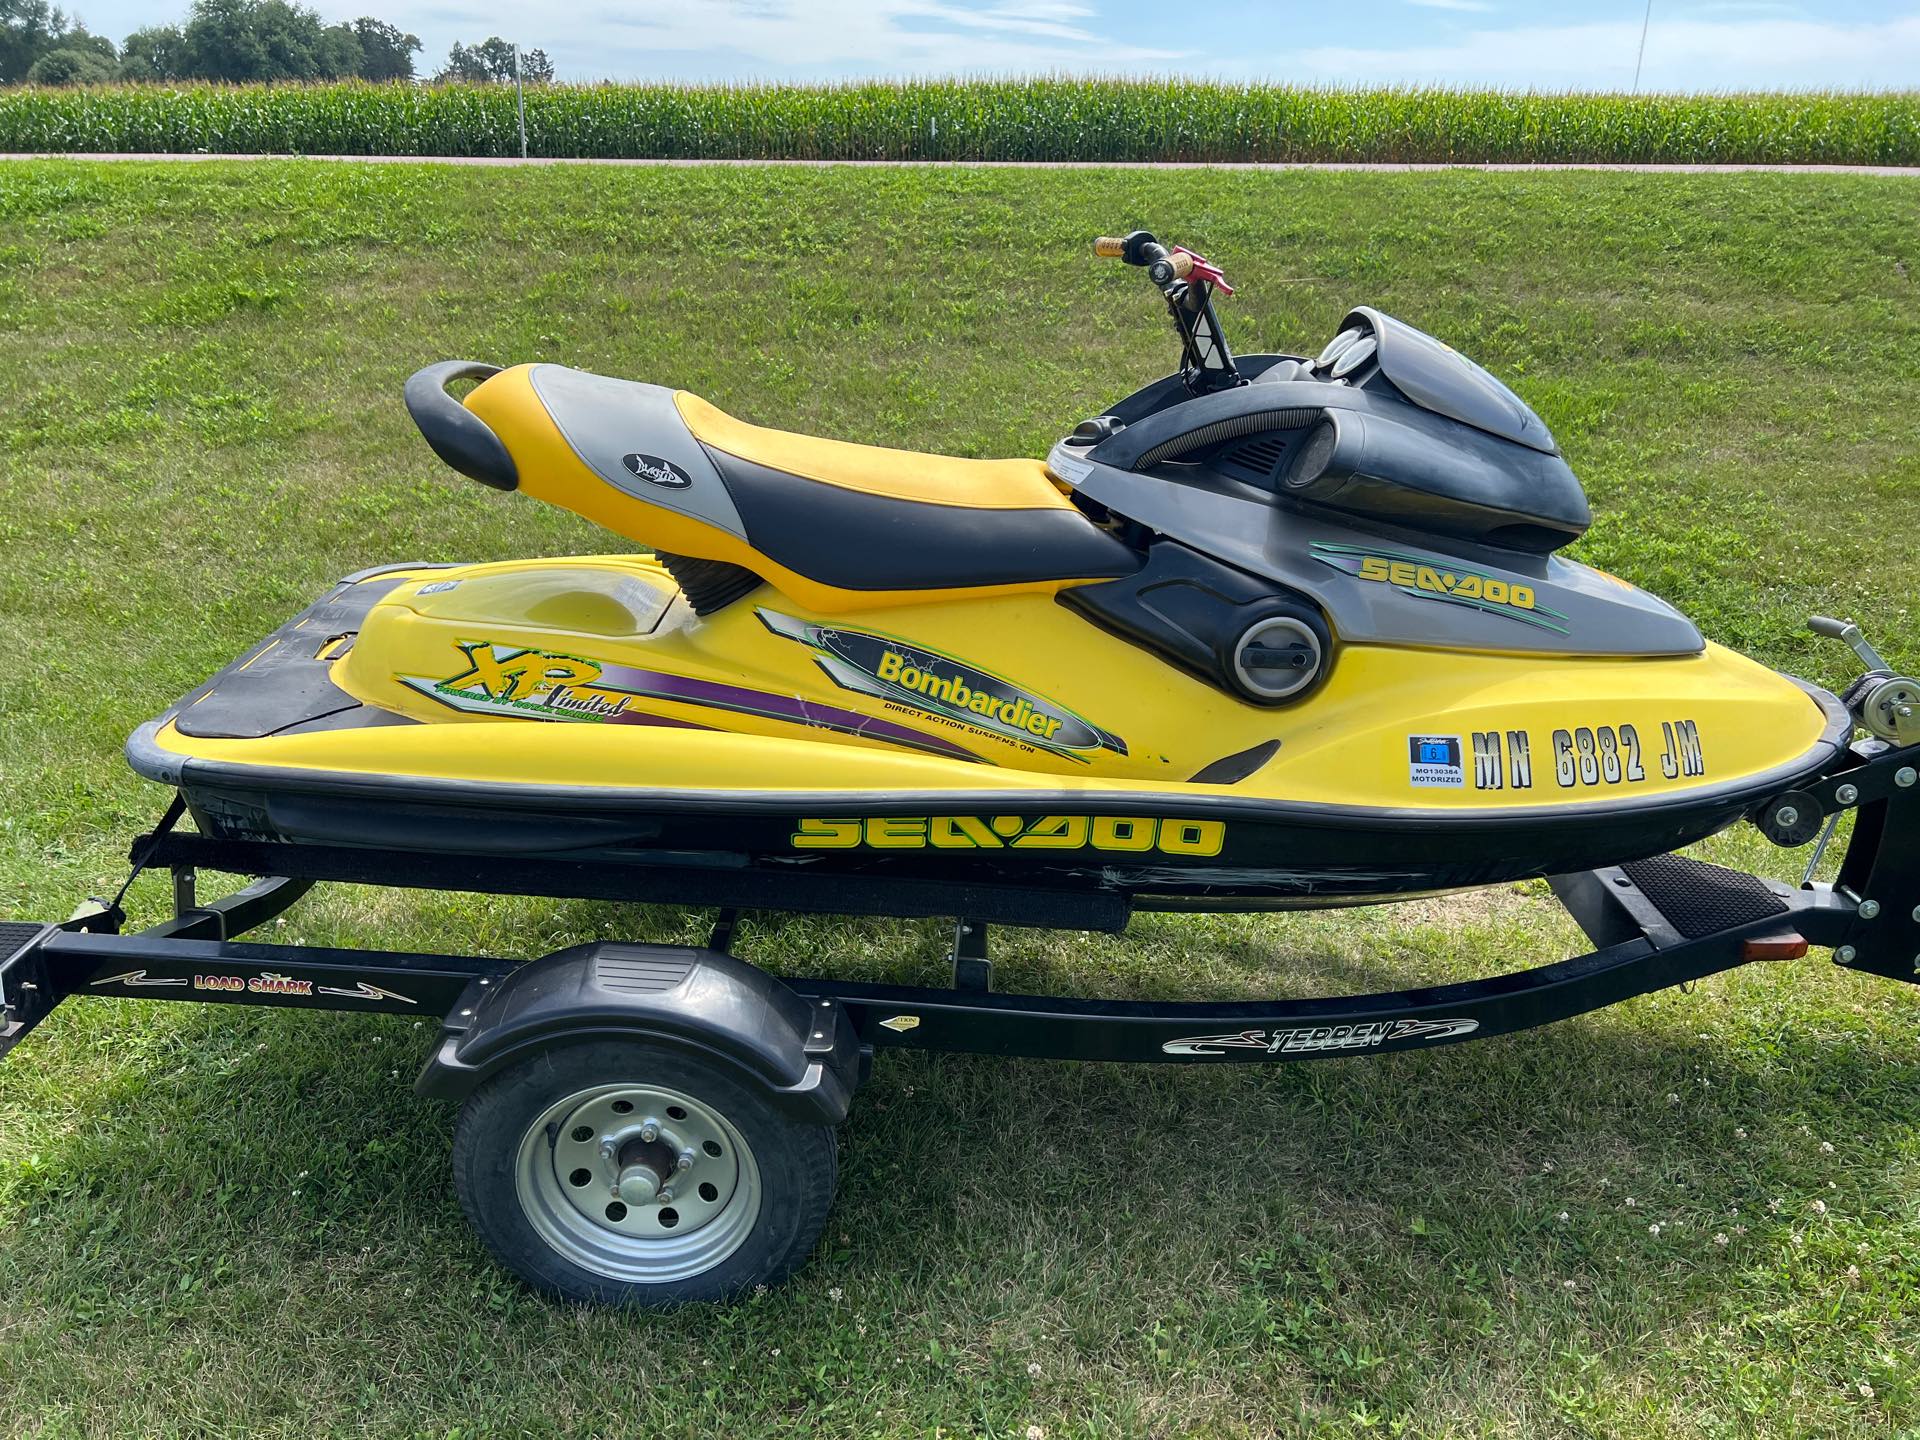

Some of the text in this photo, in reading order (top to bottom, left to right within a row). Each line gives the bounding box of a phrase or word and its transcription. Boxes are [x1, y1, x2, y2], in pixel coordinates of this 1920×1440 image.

[434, 639, 602, 701] XP
[435, 685, 604, 723] POWERED BY ROTAX MARINE
[545, 684, 632, 718] Limited
[876, 651, 1063, 740] Bombardier
[884, 702, 1035, 754] DIRECT ACTION SUSPENSON
[1552, 724, 1645, 788] 6882
[1661, 719, 1705, 780] JM
[194, 975, 313, 995] LOAD SHARK
[1267, 1021, 1394, 1053] TEBBEN
